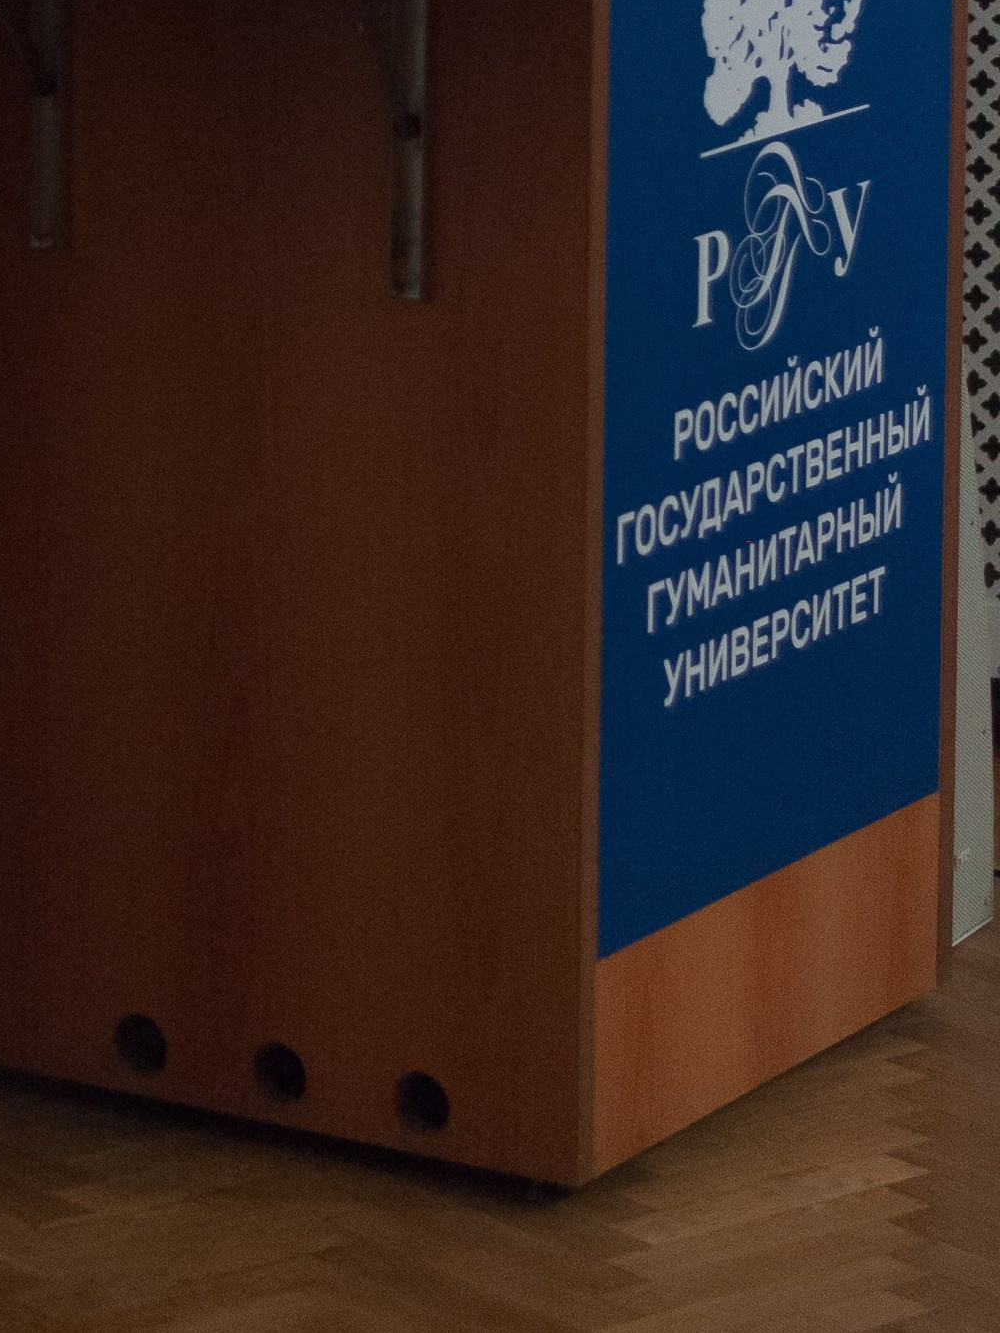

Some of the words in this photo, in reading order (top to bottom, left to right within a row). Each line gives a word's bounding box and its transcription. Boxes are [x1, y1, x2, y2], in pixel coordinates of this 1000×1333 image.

[673, 325, 885, 460] РОССИЙСКИЙ
[616, 383, 931, 565] ГОСУДАРСТВЕННЫЙ
[647, 470, 902, 634] ГУМАНИТАРНЫЙ
[663, 565, 886, 707] УНИВЕРСИТЕТ
